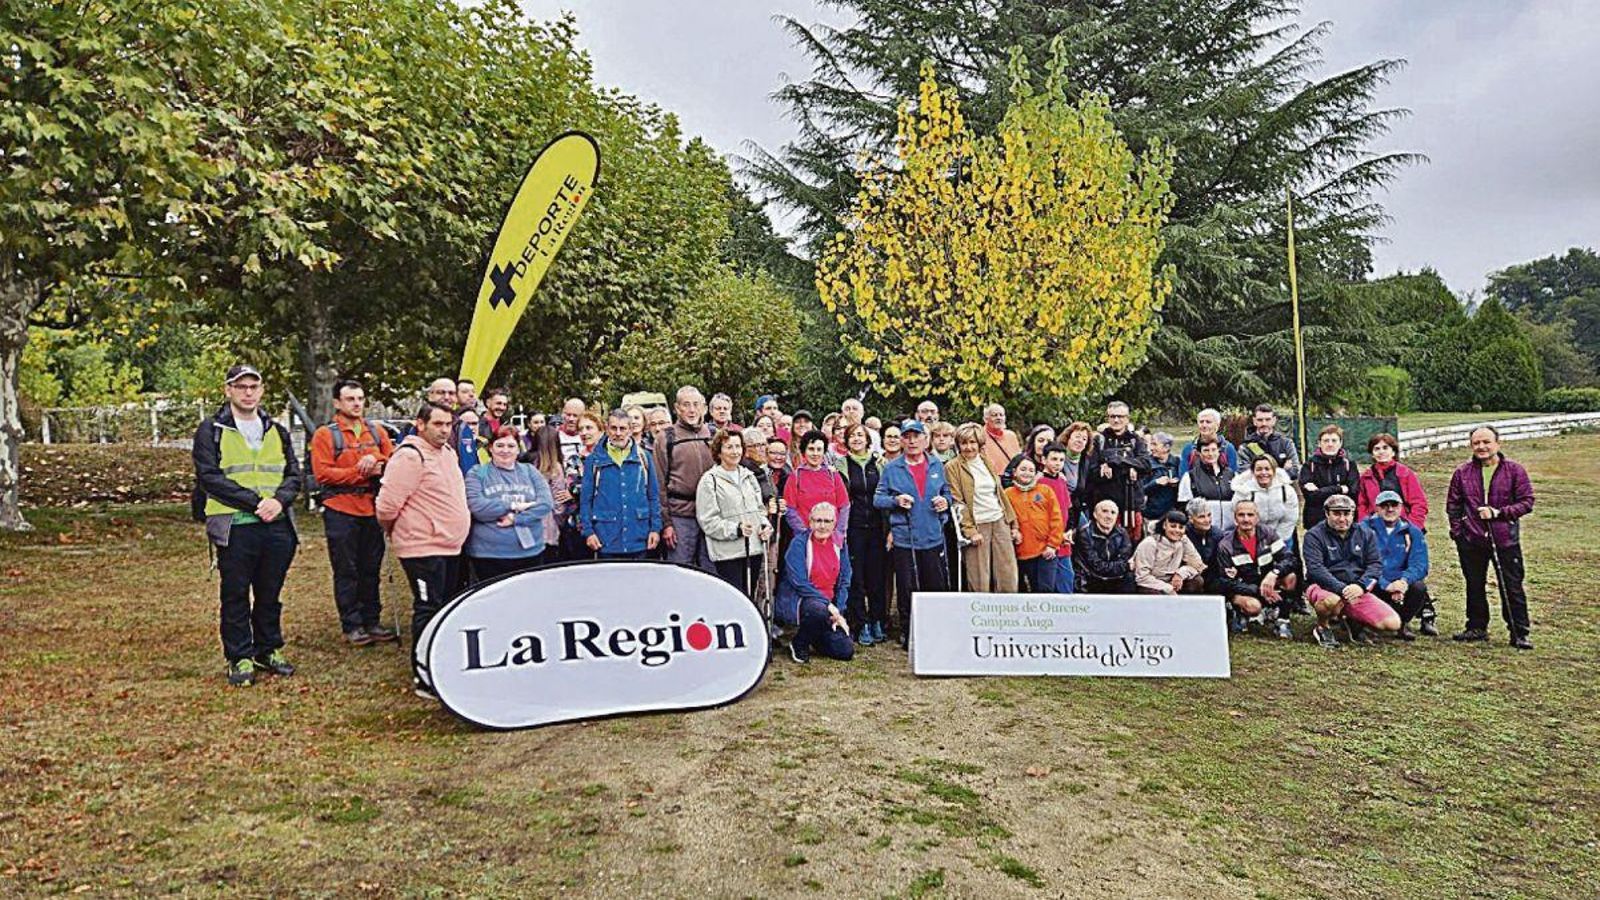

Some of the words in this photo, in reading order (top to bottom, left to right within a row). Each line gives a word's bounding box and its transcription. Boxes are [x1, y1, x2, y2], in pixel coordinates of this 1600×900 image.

[515, 174, 578, 278] DEPORTE
[970, 600, 1019, 616] Campus
[1022, 601, 1038, 613] de
[1039, 601, 1091, 613] Ourense
[970, 615, 1021, 630] Campus
[1022, 616, 1054, 630] Auga
[459, 626, 546, 672] La
[556, 612, 748, 667] Región
[972, 635, 1099, 660] Universida
[1100, 644, 1128, 667] de
[1121, 637, 1174, 666] Vigo
